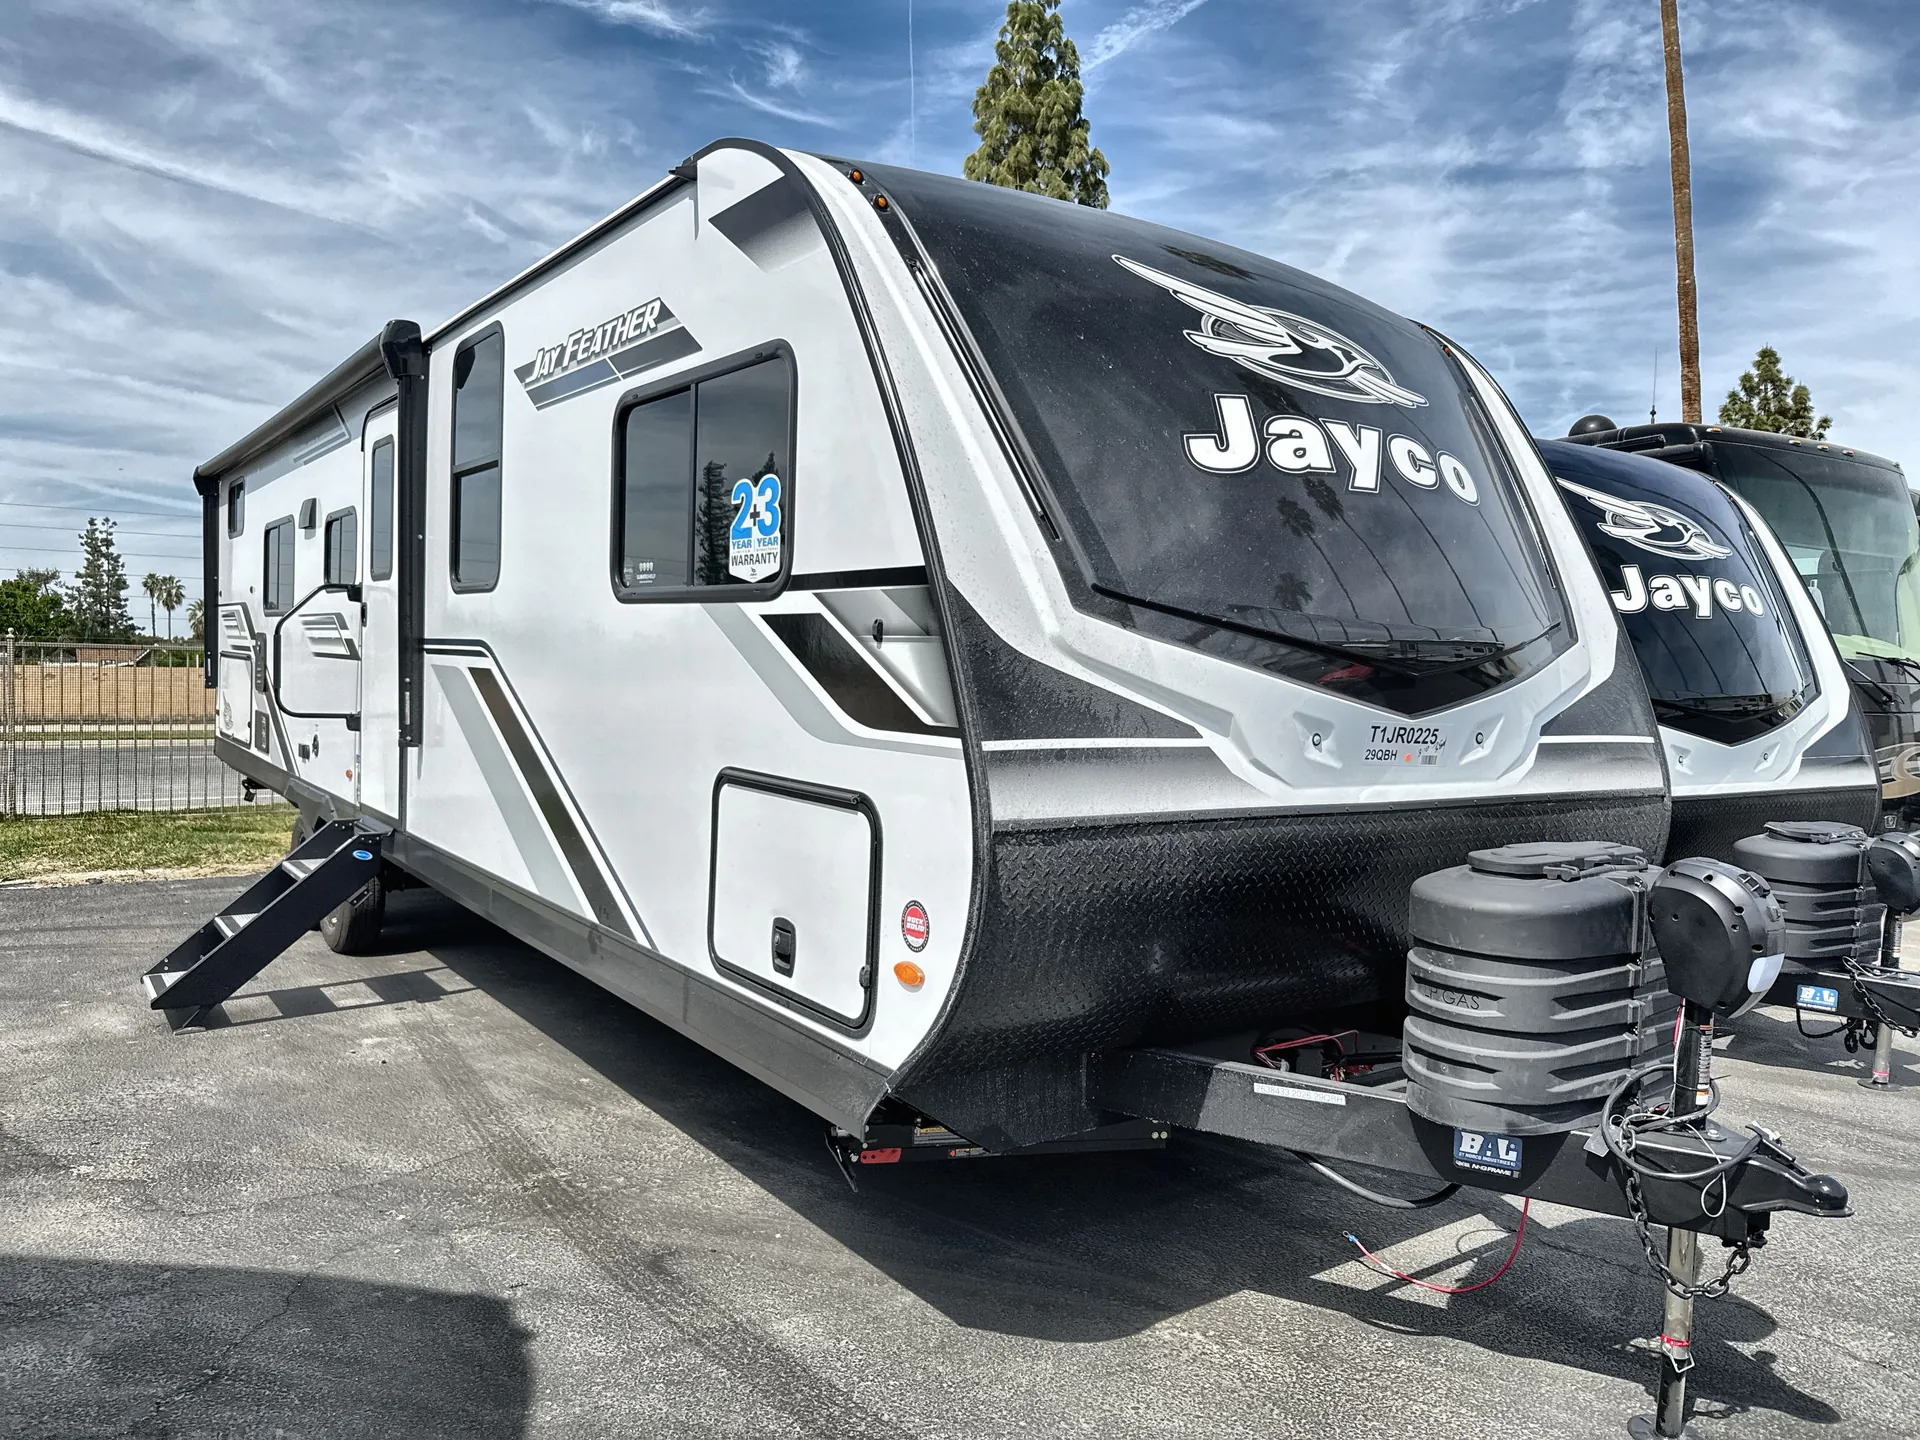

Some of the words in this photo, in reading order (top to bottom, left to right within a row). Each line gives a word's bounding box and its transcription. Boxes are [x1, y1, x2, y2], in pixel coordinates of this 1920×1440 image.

[525, 347, 562, 383] JAY
[562, 299, 661, 368] FEATHER
[1184, 394, 1480, 506] Jayco
[731, 539, 753, 550] YEAR
[757, 536, 779, 547] YEAR
[731, 552, 779, 566] WARRANTY
[1610, 564, 1765, 619] Jayco
[1371, 725, 1440, 745] T1JR0225
[1364, 748, 1398, 761] 29QBH
[1442, 989, 1480, 1010] GAS
